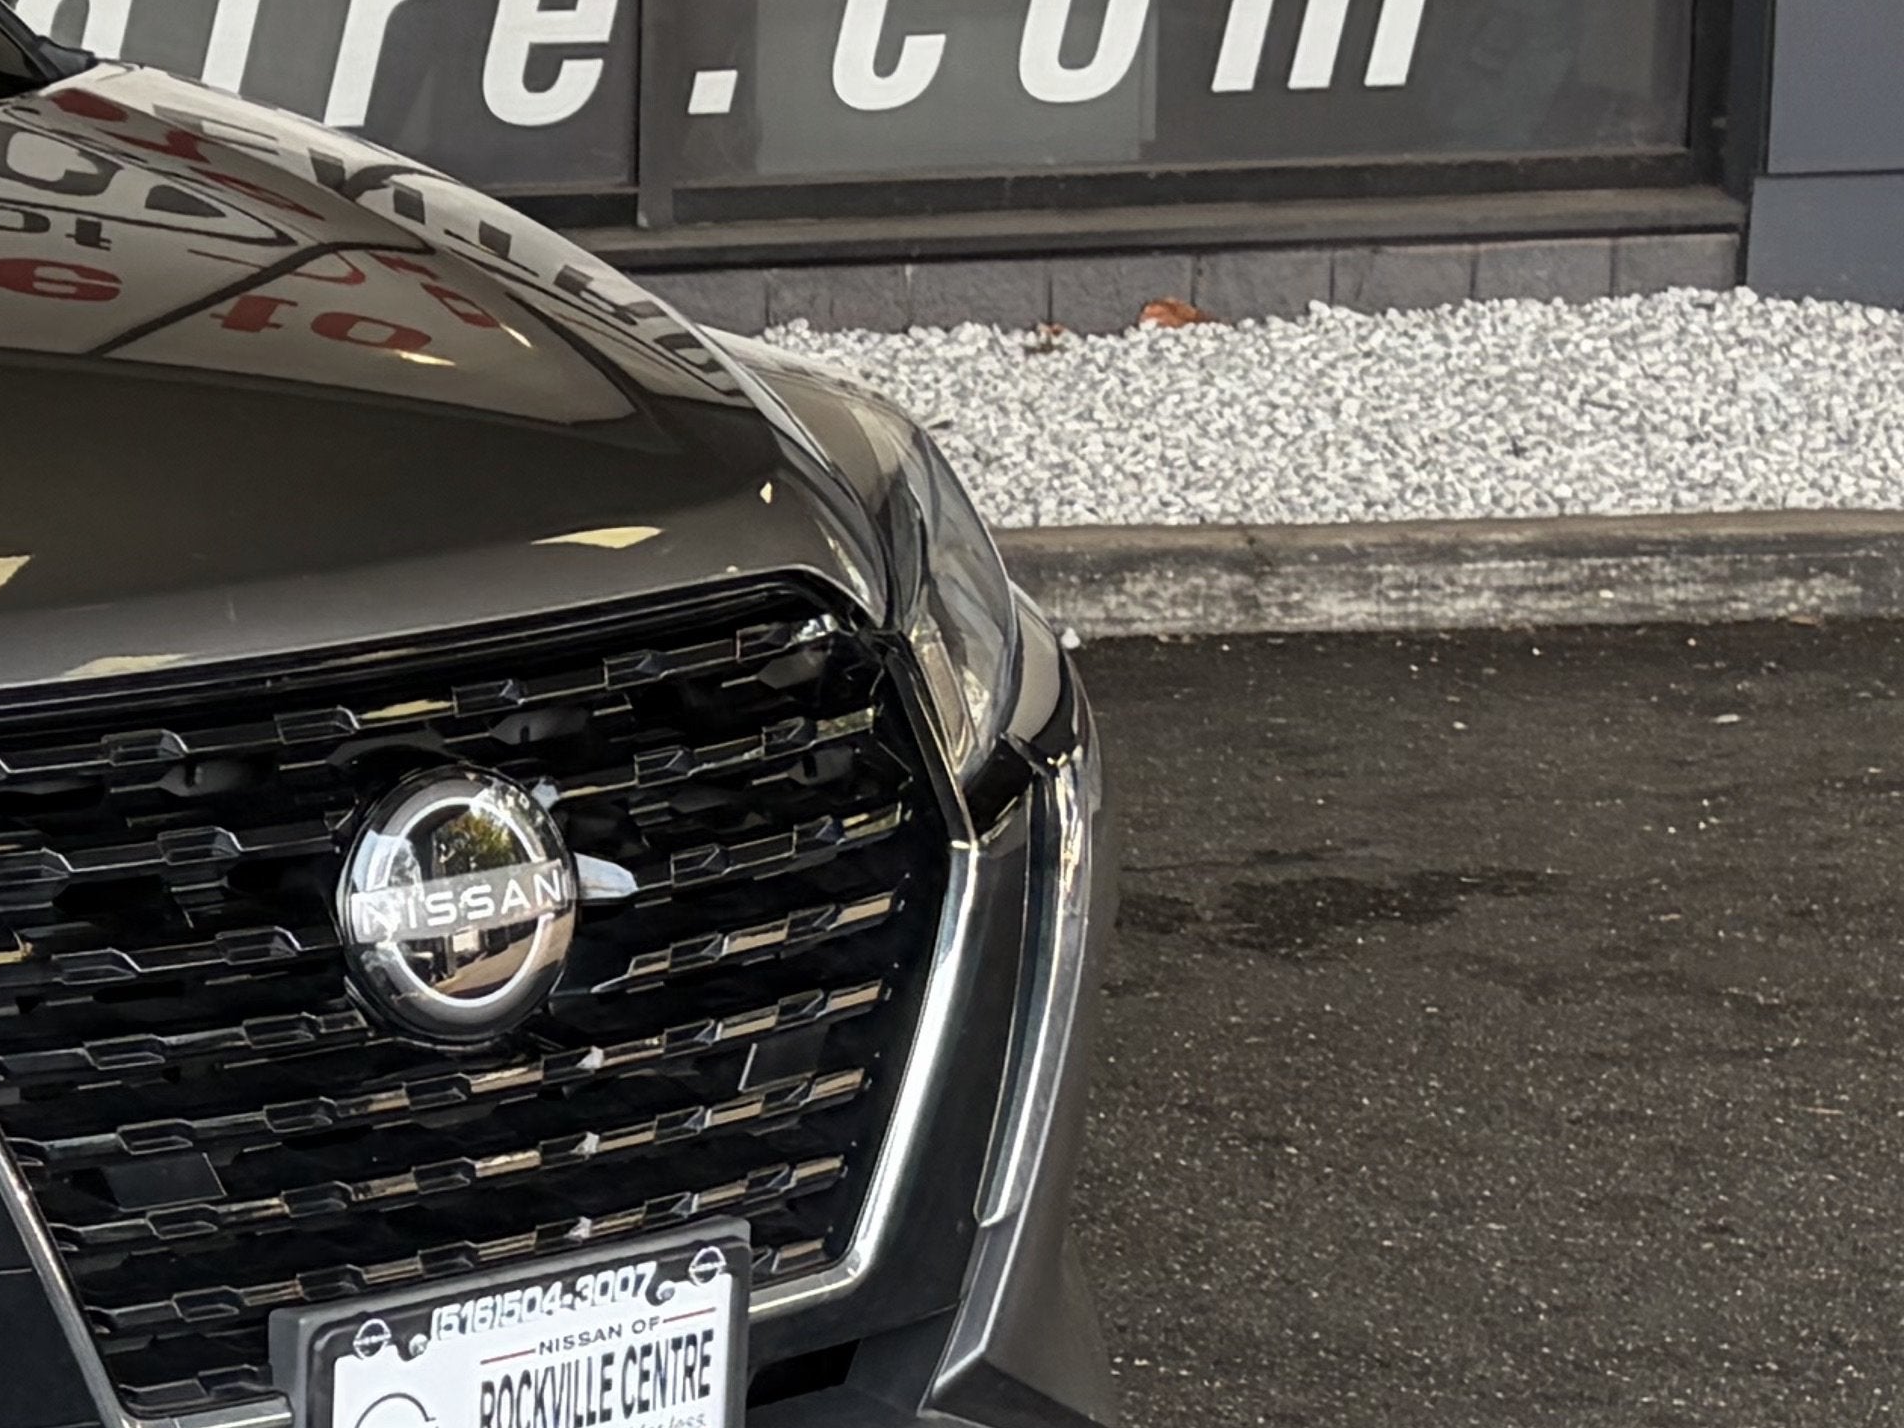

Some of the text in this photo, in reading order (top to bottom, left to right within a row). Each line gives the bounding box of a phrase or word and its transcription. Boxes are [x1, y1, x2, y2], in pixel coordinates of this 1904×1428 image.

[360, 868, 563, 936] NISSAN
[539, 1315, 660, 1355] NISSAN OF
[621, 1329, 714, 1419] CENTRE
